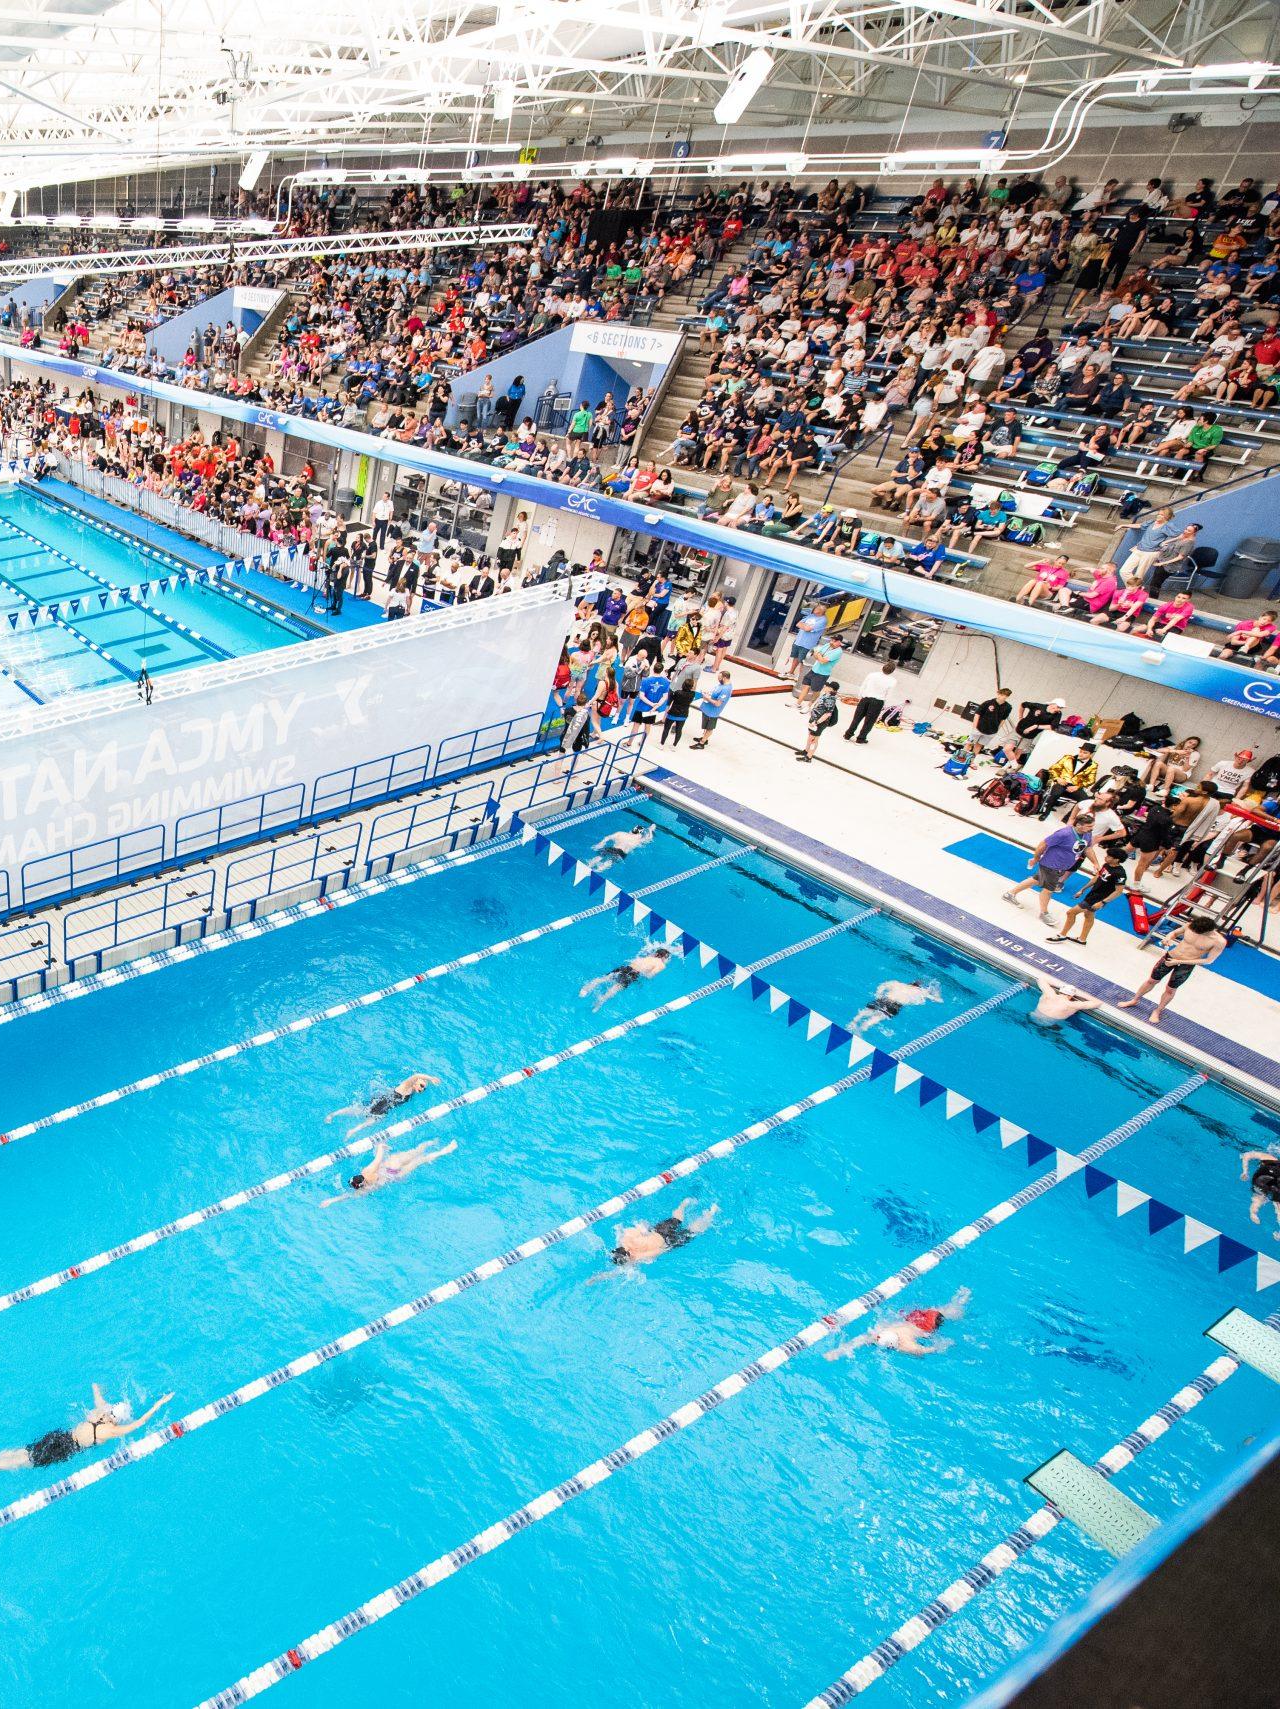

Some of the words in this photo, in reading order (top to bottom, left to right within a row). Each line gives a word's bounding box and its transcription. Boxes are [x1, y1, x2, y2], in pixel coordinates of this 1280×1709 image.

[592, 332, 600, 344] 6
[602, 334, 647, 350] SECTIONS
[650, 338, 657, 351] 7
[567, 493, 598, 512] GAC
[1221, 696, 1265, 714] GREENSBORO
[1219, 773, 1240, 785] YMCA
[1222, 769, 1243, 780] YORK
